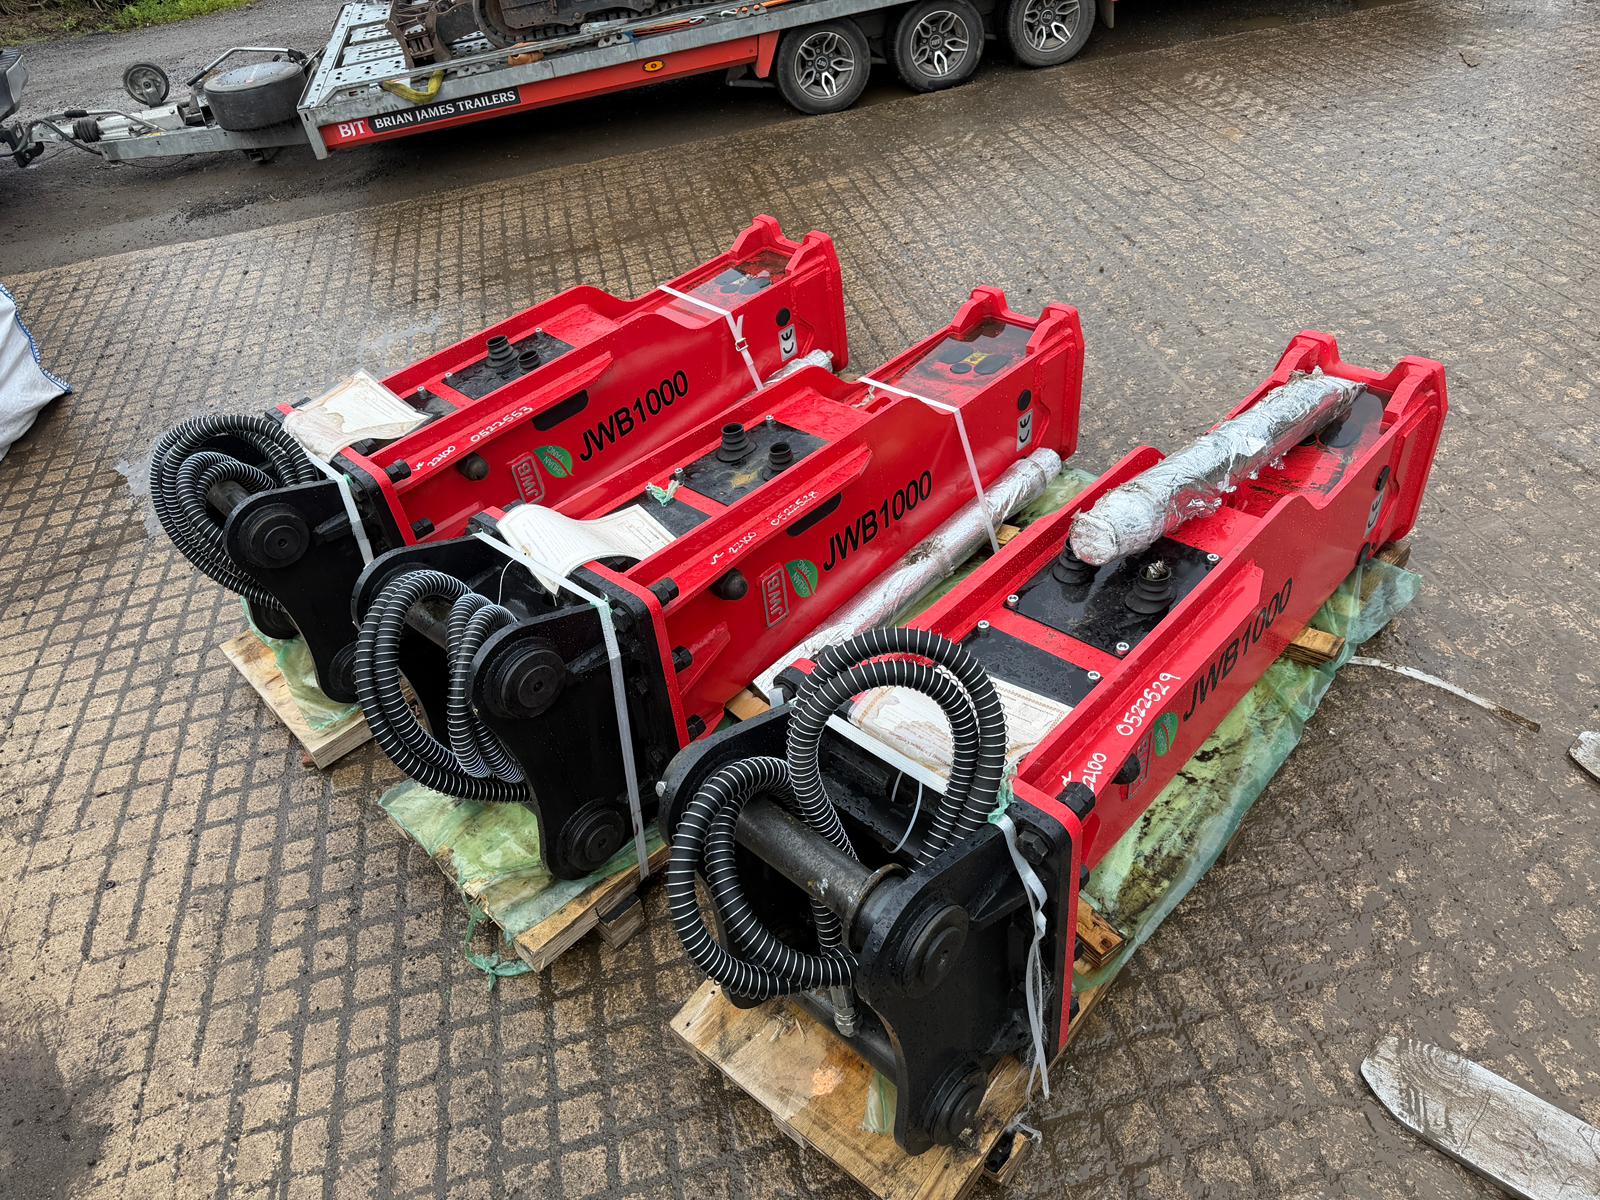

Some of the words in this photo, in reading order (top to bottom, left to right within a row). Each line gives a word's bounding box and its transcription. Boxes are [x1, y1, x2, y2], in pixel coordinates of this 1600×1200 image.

[338, 120, 366, 138] BJT
[374, 112, 414, 129] BRIAN
[416, 103, 455, 122] JAMES
[457, 90, 516, 112] TRAILERS
[781, 329, 794, 354] CE
[470, 406, 533, 442] 0522553
[579, 370, 689, 462] JWB1000
[1019, 414, 1030, 443] CE
[517, 462, 539, 497] JWB
[823, 469, 932, 572] JWB1000
[767, 575, 784, 616] JWB
[1183, 577, 1292, 722] JWB1000
[1116, 672, 1181, 736] 0522529
